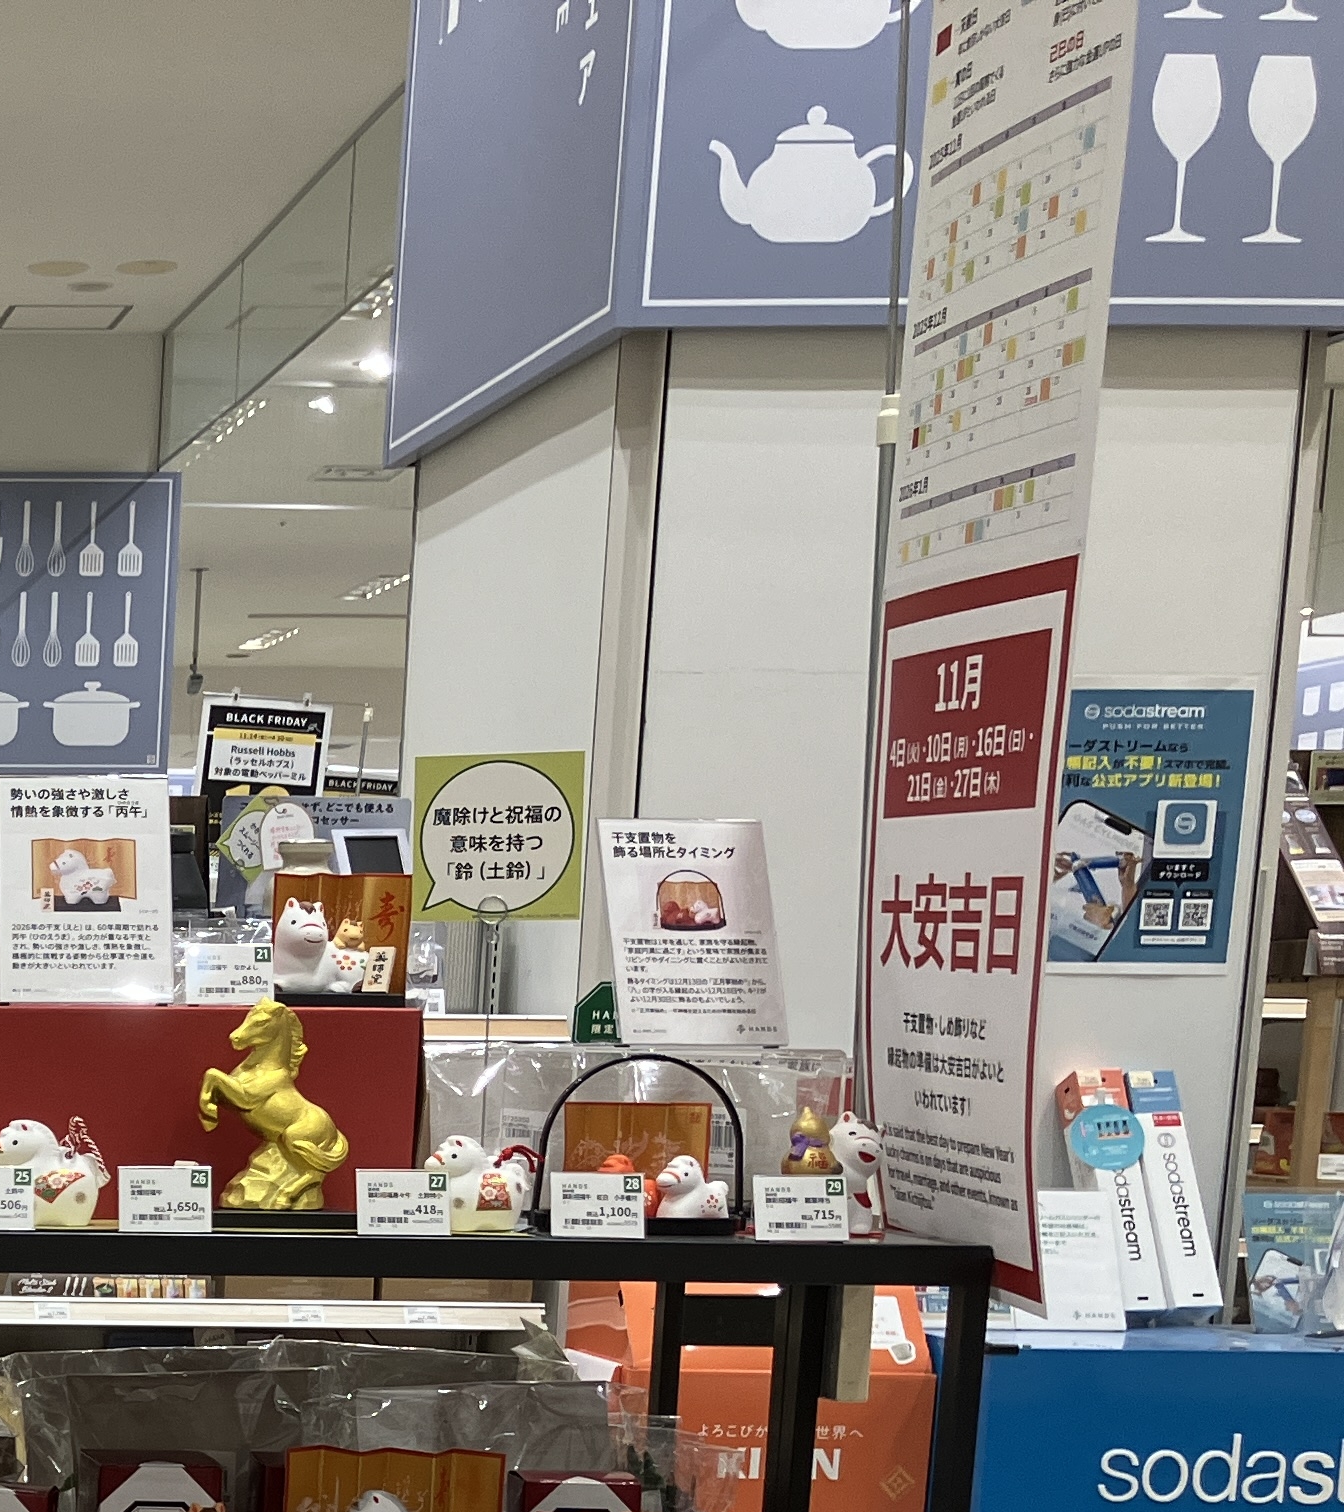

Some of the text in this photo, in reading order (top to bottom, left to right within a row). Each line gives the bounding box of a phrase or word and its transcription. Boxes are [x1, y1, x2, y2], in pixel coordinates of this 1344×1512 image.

[934, 654, 983, 712] 11月
[1104, 704, 1205, 719] sodastream
[226, 713, 308, 726] BLACK FRIDAY
[231, 746, 295, 757] Russell Hobbs
[1065, 740, 1189, 752] ーダストリームなら
[214, 767, 306, 781] 対象の電動ペッパーミル
[361, 782, 393, 791] FRIDAY
[11, 788, 129, 800] 勢いの強さや激しさ
[11, 805, 148, 818] 情熱を象徴する「丙午」
[433, 806, 562, 825] 魔除けと祝福の
[450, 835, 543, 853] 意味を持つ
[612, 832, 676, 844] 干支置物を
[613, 847, 735, 858] 飾る場所とタイミング
[880, 872, 1024, 975] 大安吉日
[256, 949, 270, 960] 21
[15, 1171, 29, 1182] 25
[430, 1176, 444, 1188] 27
[827, 1180, 842, 1192] 29
[1163, 1153, 1197, 1257] sodastream
